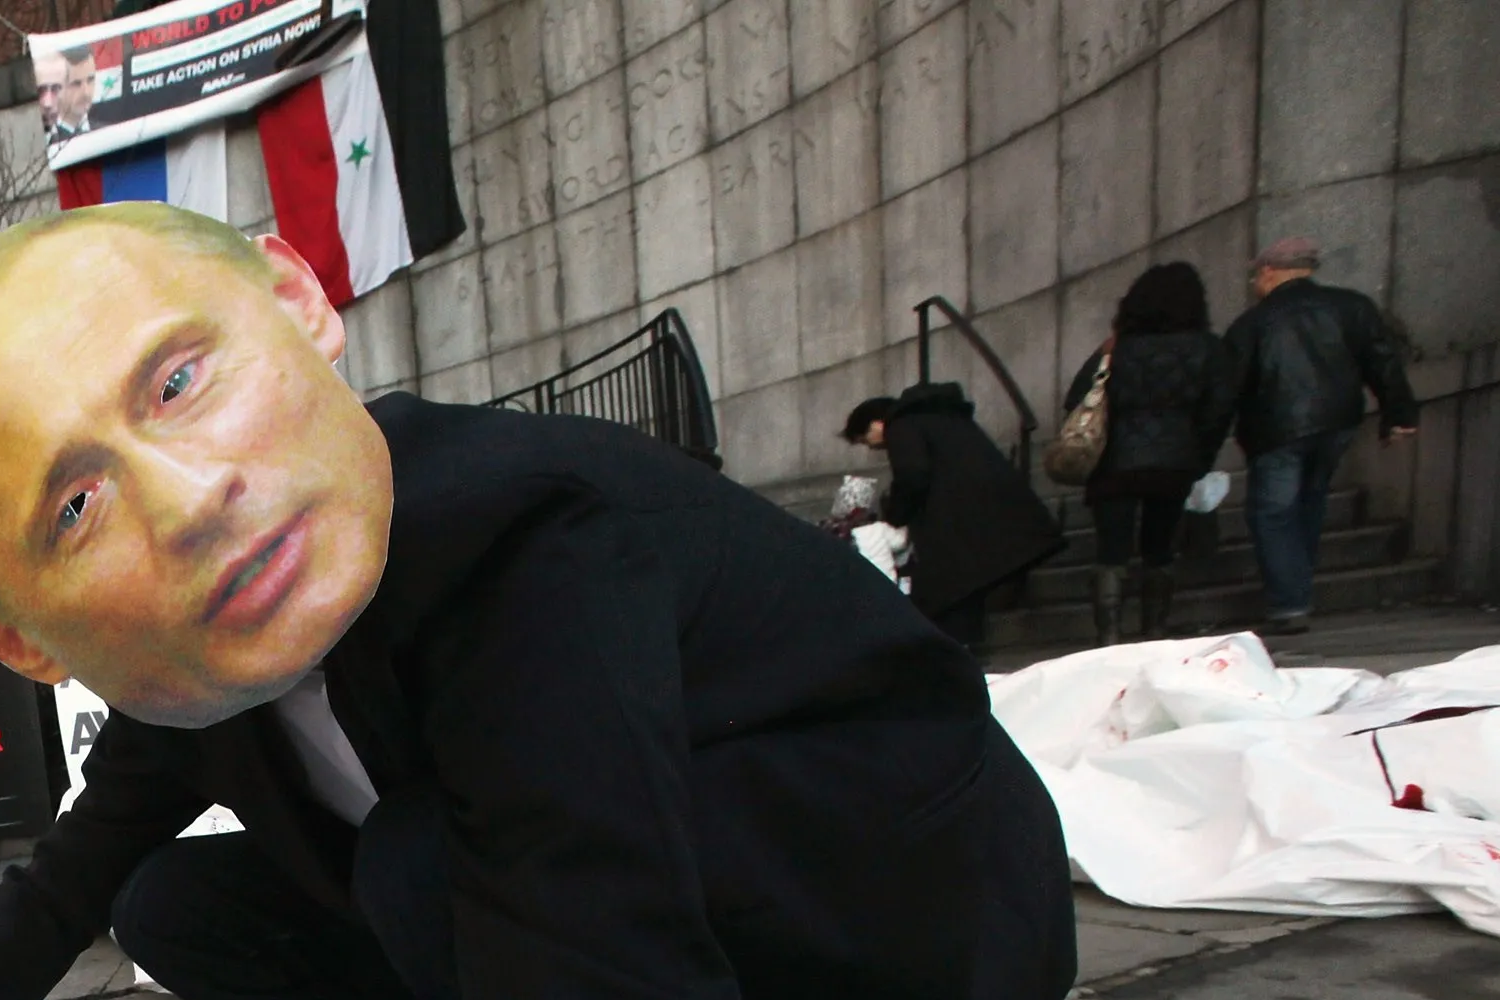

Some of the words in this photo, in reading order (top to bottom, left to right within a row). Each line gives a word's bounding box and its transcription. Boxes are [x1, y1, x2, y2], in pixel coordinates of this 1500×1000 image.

[131, 73, 164, 94] TAKE
[167, 56, 217, 85] ACTION
[219, 47, 239, 69] ON
[242, 32, 282, 60] SYRIA
[284, 14, 321, 43] NOW!
[132, 15, 210, 48] WORLD
[216, 3, 244, 25] TO
